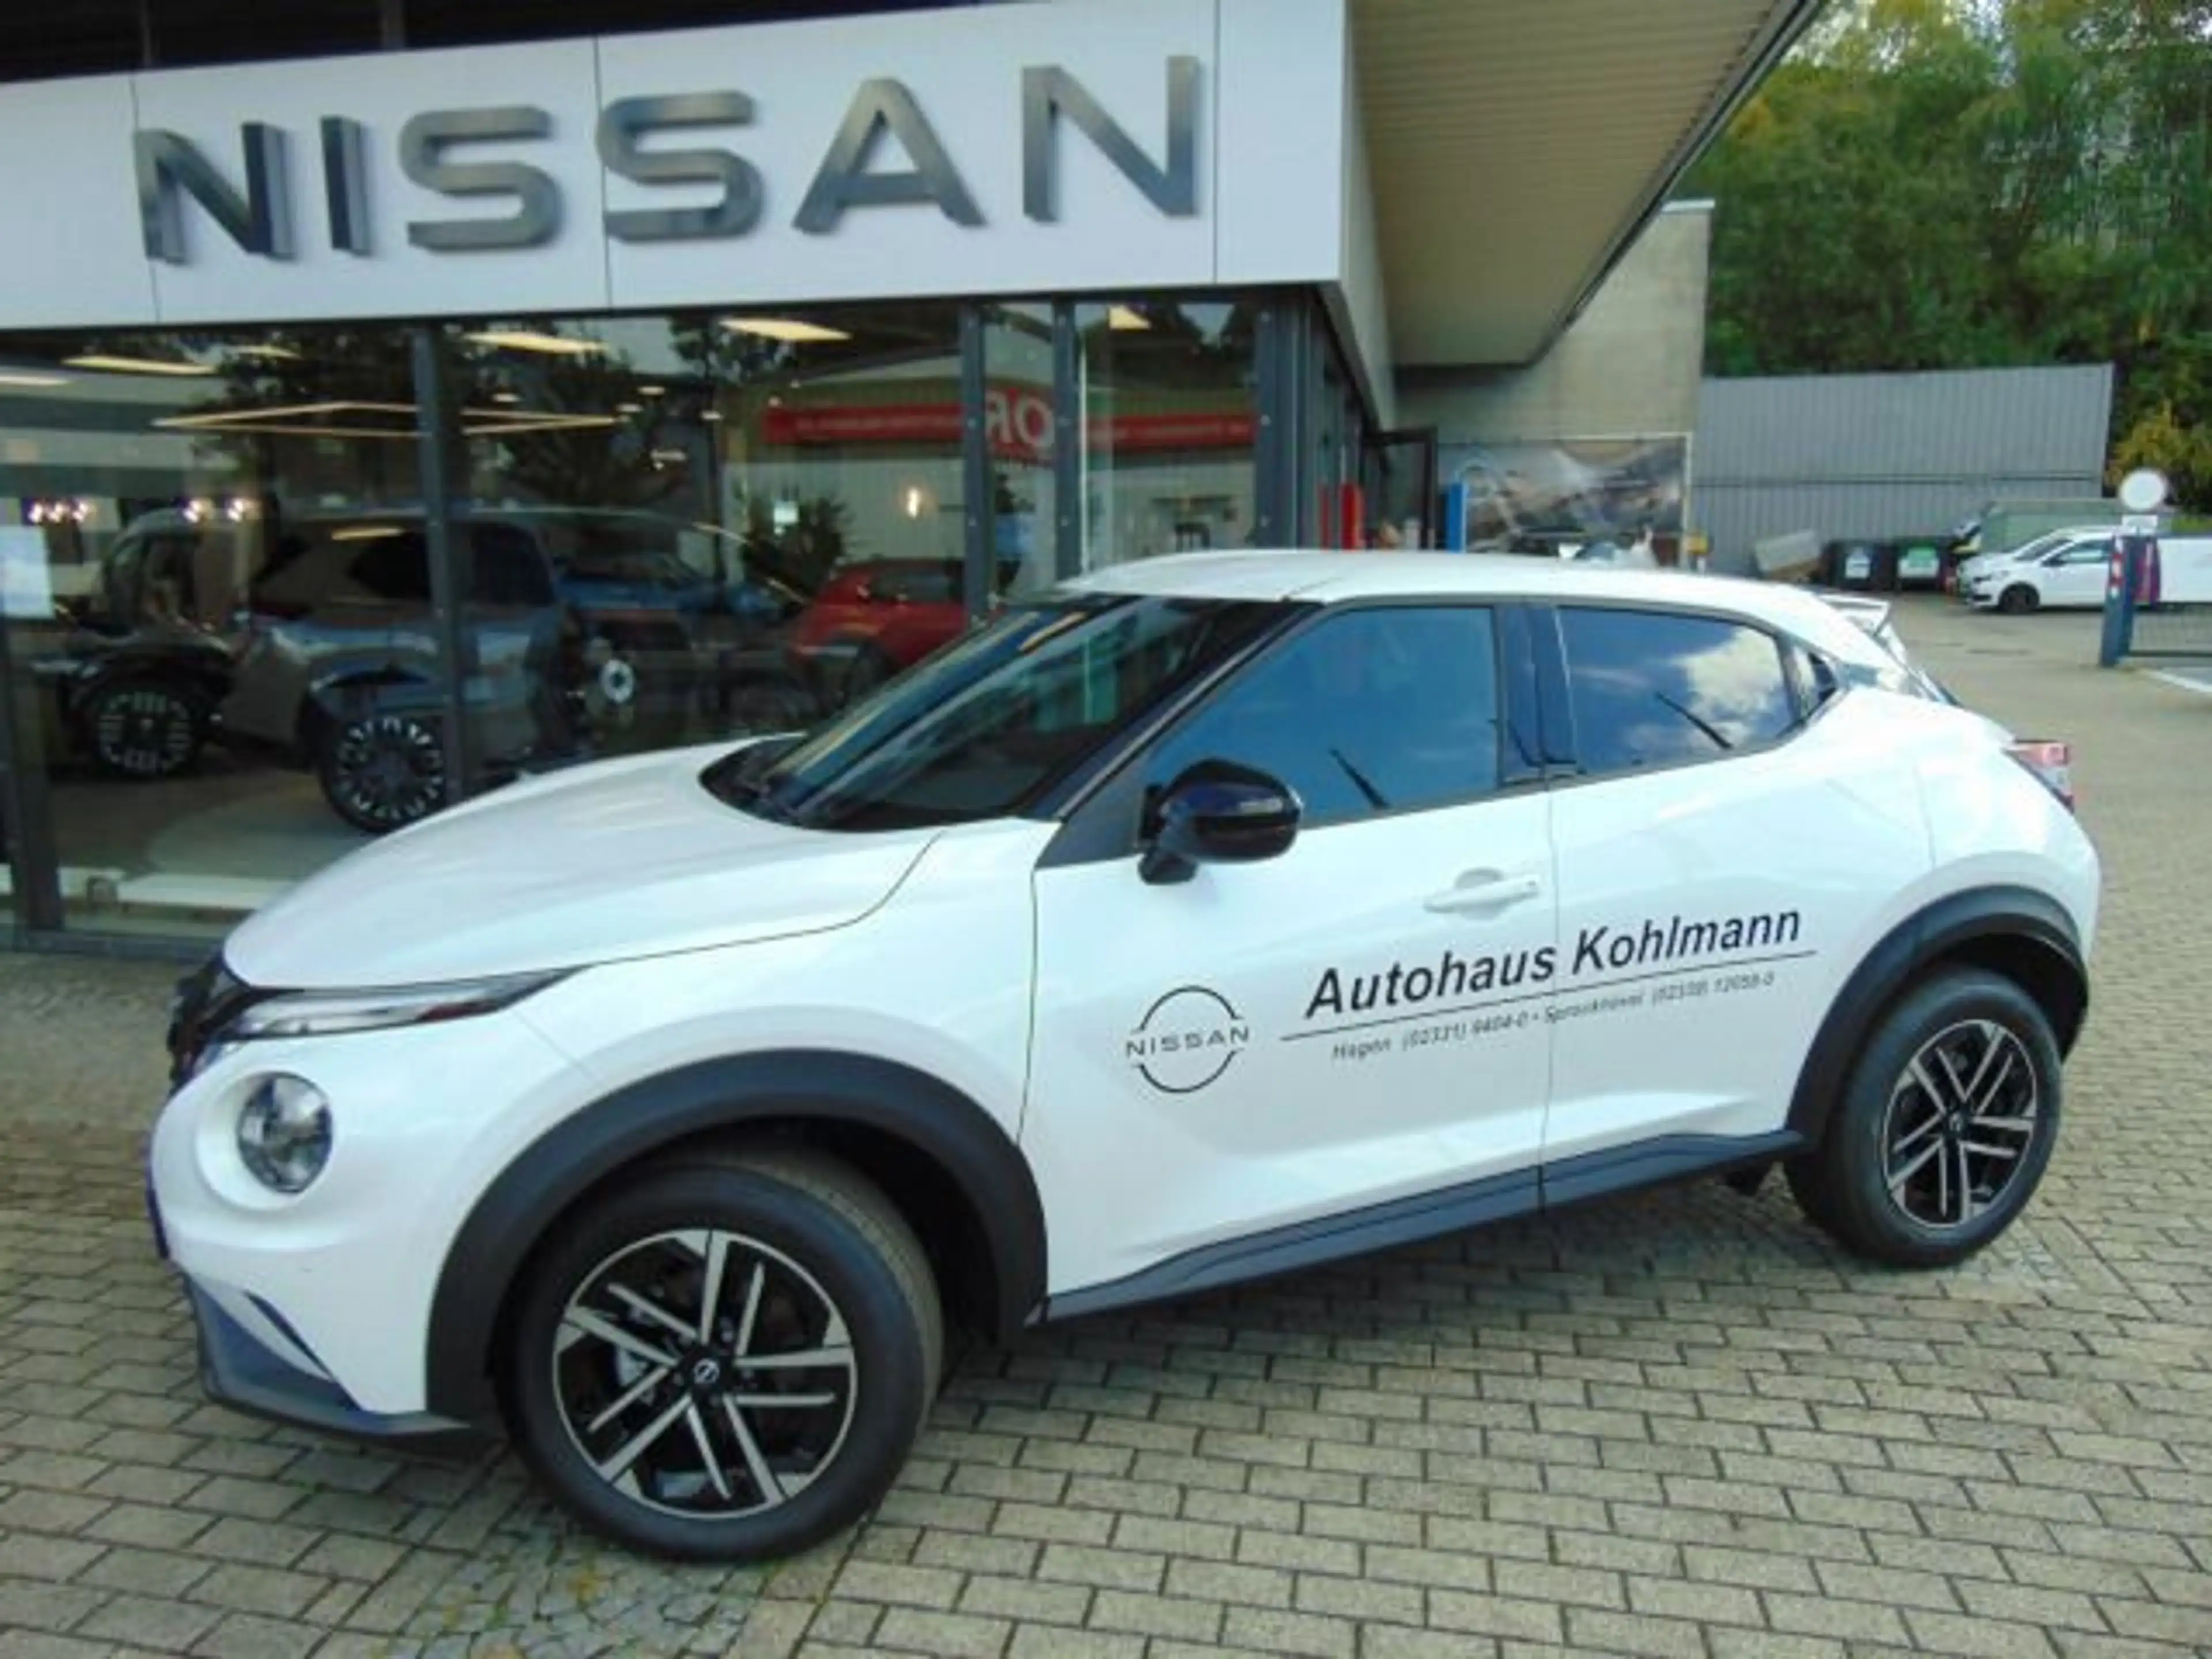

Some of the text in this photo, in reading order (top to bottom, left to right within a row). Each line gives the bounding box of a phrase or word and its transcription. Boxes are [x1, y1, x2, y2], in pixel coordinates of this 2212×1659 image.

[135, 55, 1200, 266] NISSAN
[1303, 909, 1800, 1020] Autohaus Kohlmann
[1126, 1025, 1249, 1058] NISSAN
